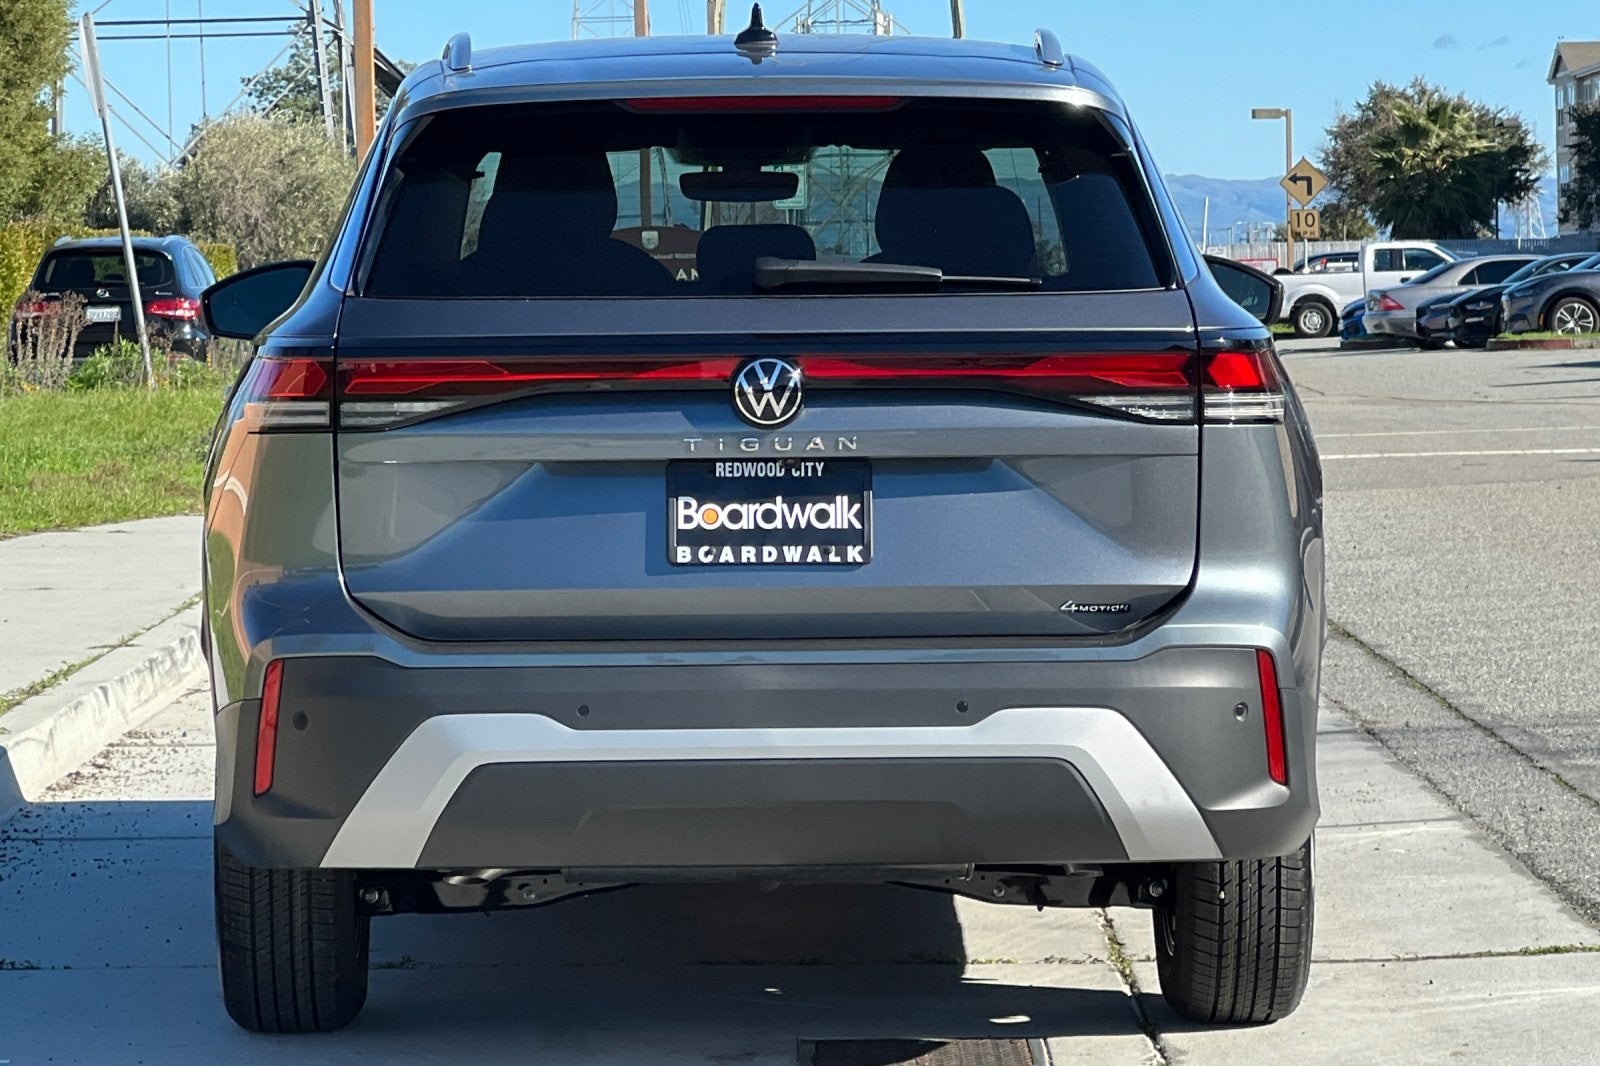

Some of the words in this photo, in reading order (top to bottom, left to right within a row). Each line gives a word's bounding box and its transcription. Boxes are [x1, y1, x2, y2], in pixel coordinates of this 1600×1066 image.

[1296, 212, 1315, 228] 10
[715, 462, 785, 478] REDWOOD
[677, 495, 862, 531] Boardwalk
[676, 545, 864, 564] BOARDWALK
[1060, 600, 1129, 613] 4MOTION
